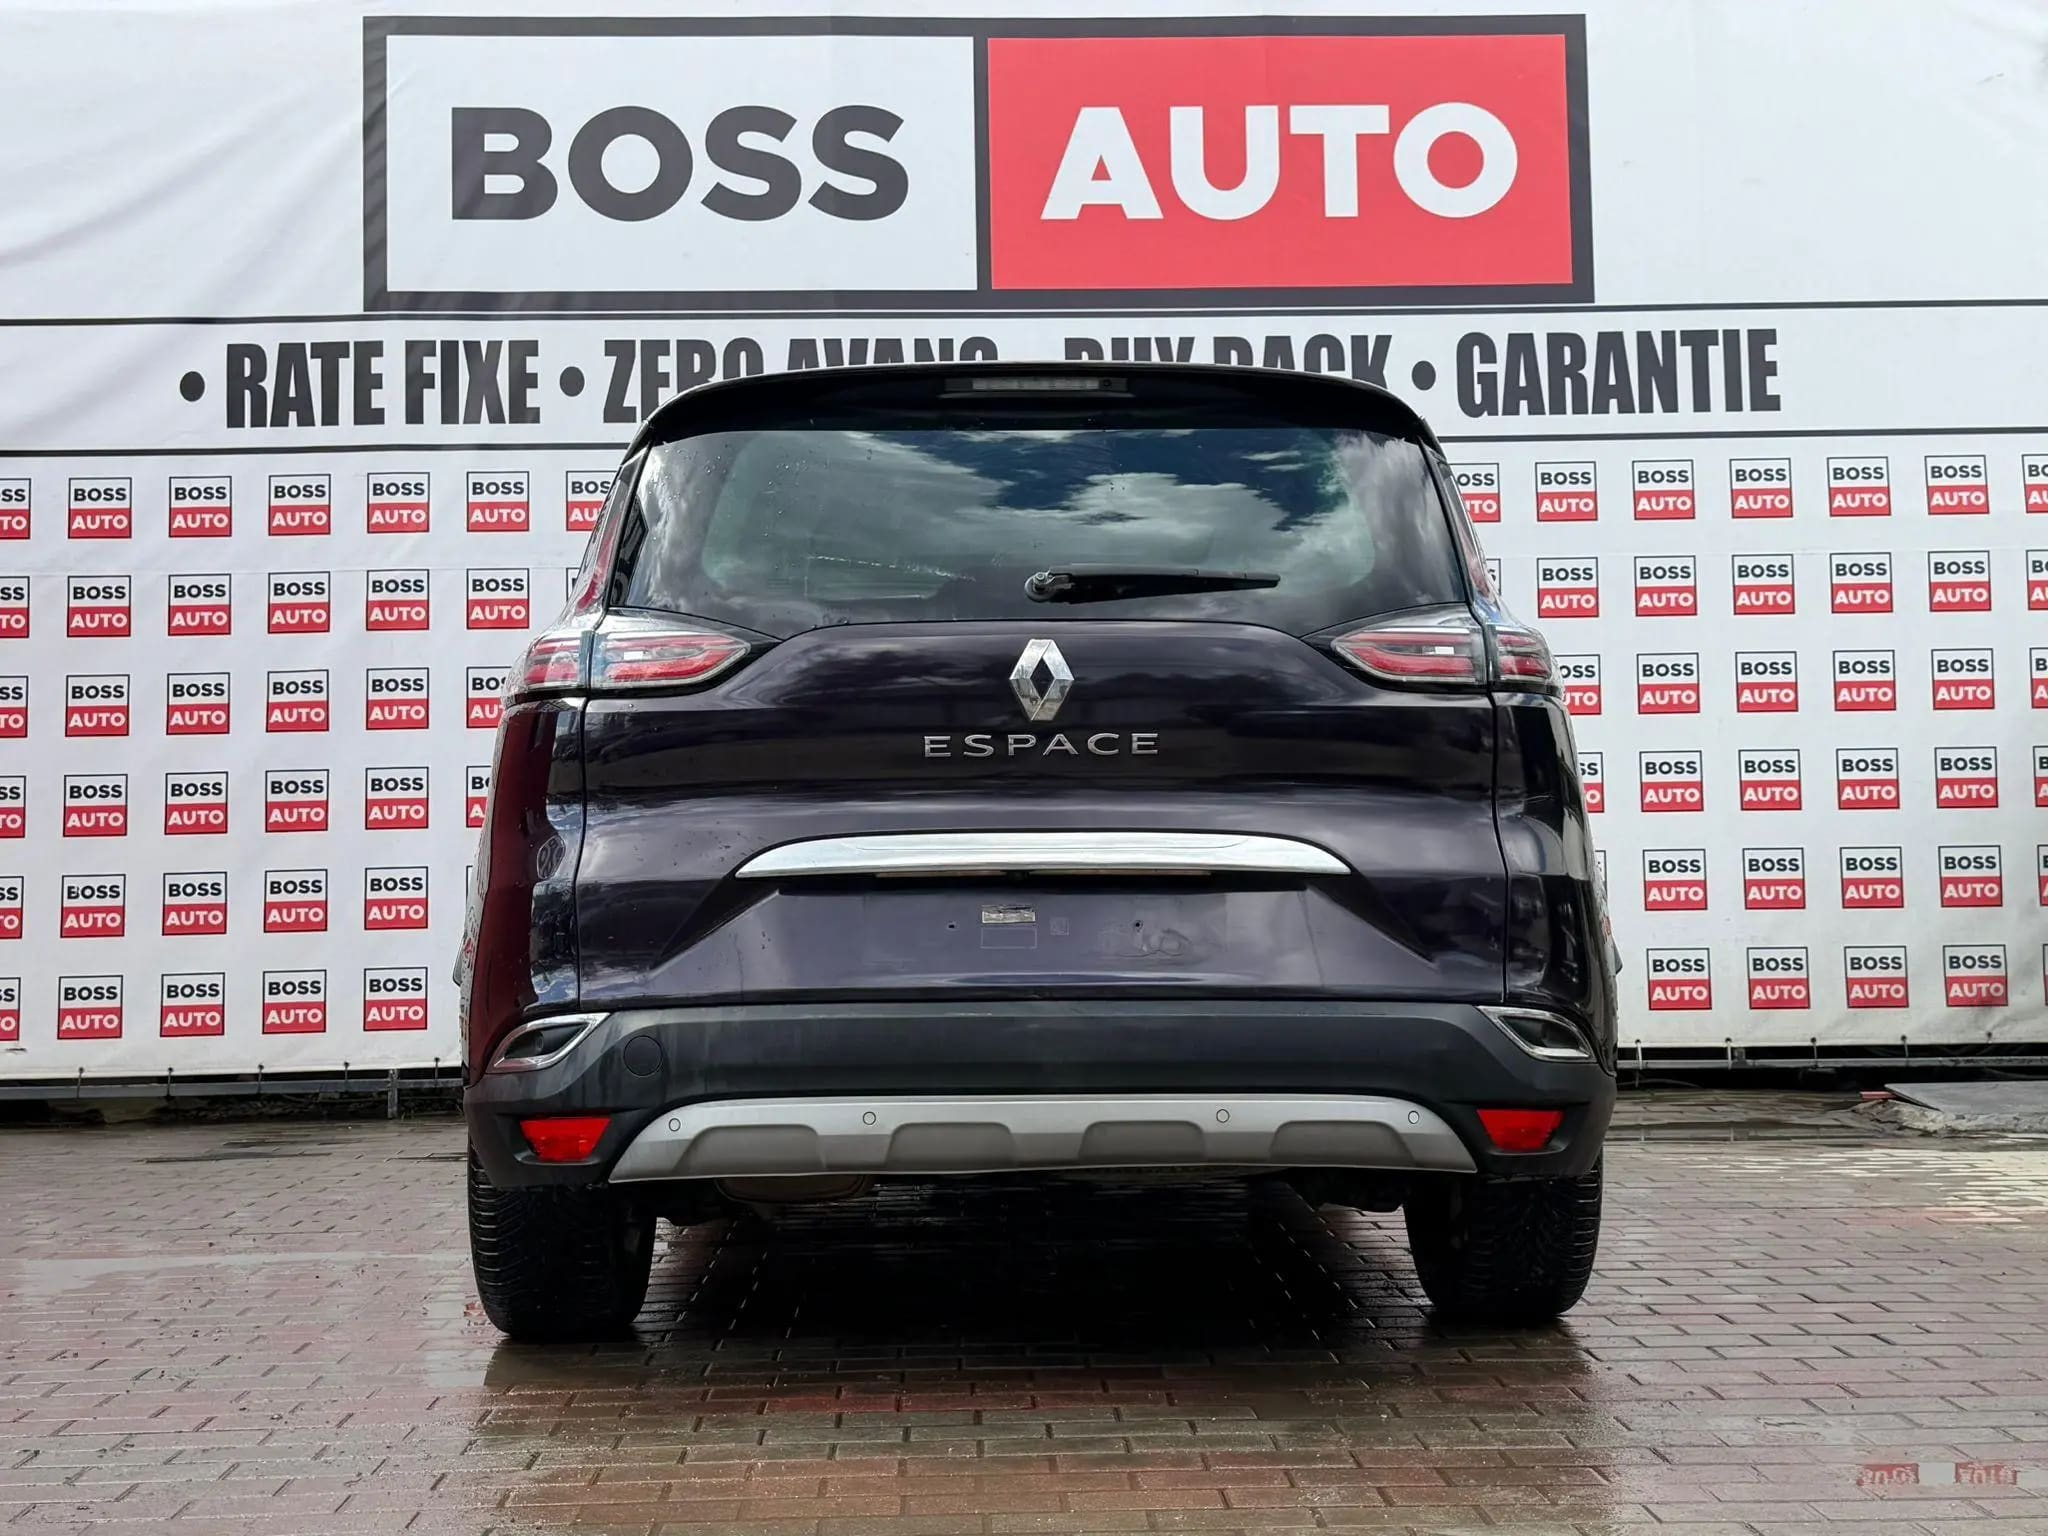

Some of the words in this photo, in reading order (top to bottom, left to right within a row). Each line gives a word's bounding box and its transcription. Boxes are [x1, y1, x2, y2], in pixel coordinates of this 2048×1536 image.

[451, 105, 909, 221] BOSS
[1041, 102, 1518, 220] AUTO
[226, 340, 384, 427] RATE
[405, 340, 539, 425] FIXE
[1456, 328, 1781, 418] GARANTIE
[1541, 471, 1592, 485] BOSS
[1638, 469, 1689, 483] BOSS
[1735, 468, 1787, 481] BOSS
[1833, 466, 1884, 480] BOSS
[1930, 464, 1983, 478] BOSS
[571, 480, 611, 494] BOS
[1456, 473, 1495, 486] OSS
[0, 488, 26, 502] SS
[74, 487, 127, 501] BOSS
[175, 486, 227, 500] BOSS
[275, 484, 326, 498] BOSS
[373, 482, 425, 496] BOSS
[474, 481, 525, 495] BOSS
[1539, 497, 1595, 512] AUTO
[1636, 496, 1693, 511] AUTO
[1734, 494, 1790, 509] AUTO
[1831, 492, 1888, 508] AUTO
[1930, 490, 1987, 506] AUTO
[71, 514, 129, 529] AUTO
[172, 513, 229, 528] AUTO
[271, 511, 328, 526] AUTO
[370, 509, 427, 523] AUTO
[470, 508, 526, 522] AUTO
[570, 507, 601, 522] AU
[0, 516, 27, 530] TO
[1542, 567, 1594, 581] BOSS
[1639, 565, 1692, 579] BOSS
[1738, 564, 1789, 577] BOSS
[1836, 562, 1887, 576] BOSS
[1934, 560, 1986, 574] BOSS
[73, 585, 126, 600] BOSS
[174, 583, 227, 598] BOSS
[274, 581, 326, 596] BOSS
[372, 578, 425, 593] BOSS
[472, 578, 525, 592] BOSS
[0, 586, 25, 600] SS
[1638, 592, 1694, 607] AUTO
[1736, 590, 1792, 605] AUTO
[1834, 589, 1890, 604] AUTO
[1932, 587, 1989, 602] AUTO
[1540, 594, 1597, 608] AUTO
[171, 611, 228, 626] AUTO
[271, 609, 327, 624] AUTO
[369, 606, 426, 621] AUTO
[469, 605, 526, 619] AUTO
[0, 614, 26, 629] TO
[70, 613, 128, 627] AUTO
[1559, 664, 1596, 678] OSS
[1642, 663, 1694, 677] BOSS
[1741, 661, 1793, 675] BOSS
[1839, 660, 1891, 674] BOSS
[1937, 658, 1989, 672] BOSS
[72, 684, 125, 699] BOSS
[173, 682, 226, 697] BOSS
[273, 679, 324, 695] BOSS
[372, 677, 425, 692] BOSS
[1562, 691, 1599, 706] UTO
[1640, 689, 1697, 704] AUTO
[1739, 688, 1796, 703] AUTO
[1837, 687, 1893, 702] AUTO
[1935, 685, 1992, 700] AUTO
[69, 712, 126, 727] AUTO
[169, 710, 227, 725] AUTO
[269, 707, 326, 722] AUTO
[369, 705, 426, 720] AUTO
[924, 733, 1159, 758] ESPACE
[1645, 760, 1698, 774] BOSS
[1745, 759, 1796, 773] BOSS
[1843, 758, 1894, 772] BOSS
[1941, 756, 1993, 771] BOSS
[70, 784, 122, 799] BOSS
[171, 781, 223, 797] BOSS
[271, 779, 324, 794] BOSS
[371, 777, 424, 791] BOSS
[1939, 784, 1995, 798] AUTO
[1643, 787, 1701, 802] AUTO
[1743, 786, 1799, 801] AUTO
[1841, 785, 1897, 800] AUTO
[66, 812, 124, 827] AUTO
[168, 810, 224, 825] AUTO
[268, 807, 325, 822] AUTO
[368, 805, 425, 819] AUTO
[1649, 859, 1701, 873] BOSS
[1749, 857, 1800, 872] BOSS
[1846, 856, 1898, 871] BOSS
[1945, 855, 1997, 869] BOSS
[169, 882, 222, 897] BOSS
[270, 879, 323, 894] BOSS
[370, 876, 423, 891] BOSS
[1943, 883, 1999, 897] AUTO
[67, 884, 120, 899] BOSS
[1647, 886, 1704, 901] AUTO
[1747, 885, 1803, 899] AUTO
[1844, 884, 1901, 899] AUTO
[165, 910, 224, 925] AUTO
[267, 907, 324, 922] AUTO
[368, 904, 425, 920] AUTO
[64, 913, 121, 927] AUTO
[1653, 958, 1705, 972] BOSS
[1753, 957, 1804, 971] BOSS
[1851, 956, 1903, 970] BOSS
[1950, 954, 2002, 969] BOSS
[167, 982, 220, 998] BOSS
[269, 980, 321, 995] BOSS
[369, 977, 422, 992] BOSS
[1752, 985, 1807, 999] AUTO
[1849, 984, 1905, 998] AUTO
[1949, 983, 2004, 997] AUTO
[64, 985, 117, 1001] BOSS
[1652, 986, 1708, 1000] AUTO
[163, 1011, 221, 1026] AUTO
[265, 1008, 323, 1024] AUTO
[366, 1005, 424, 1021] AUTO
[61, 1014, 119, 1029] AUTO
